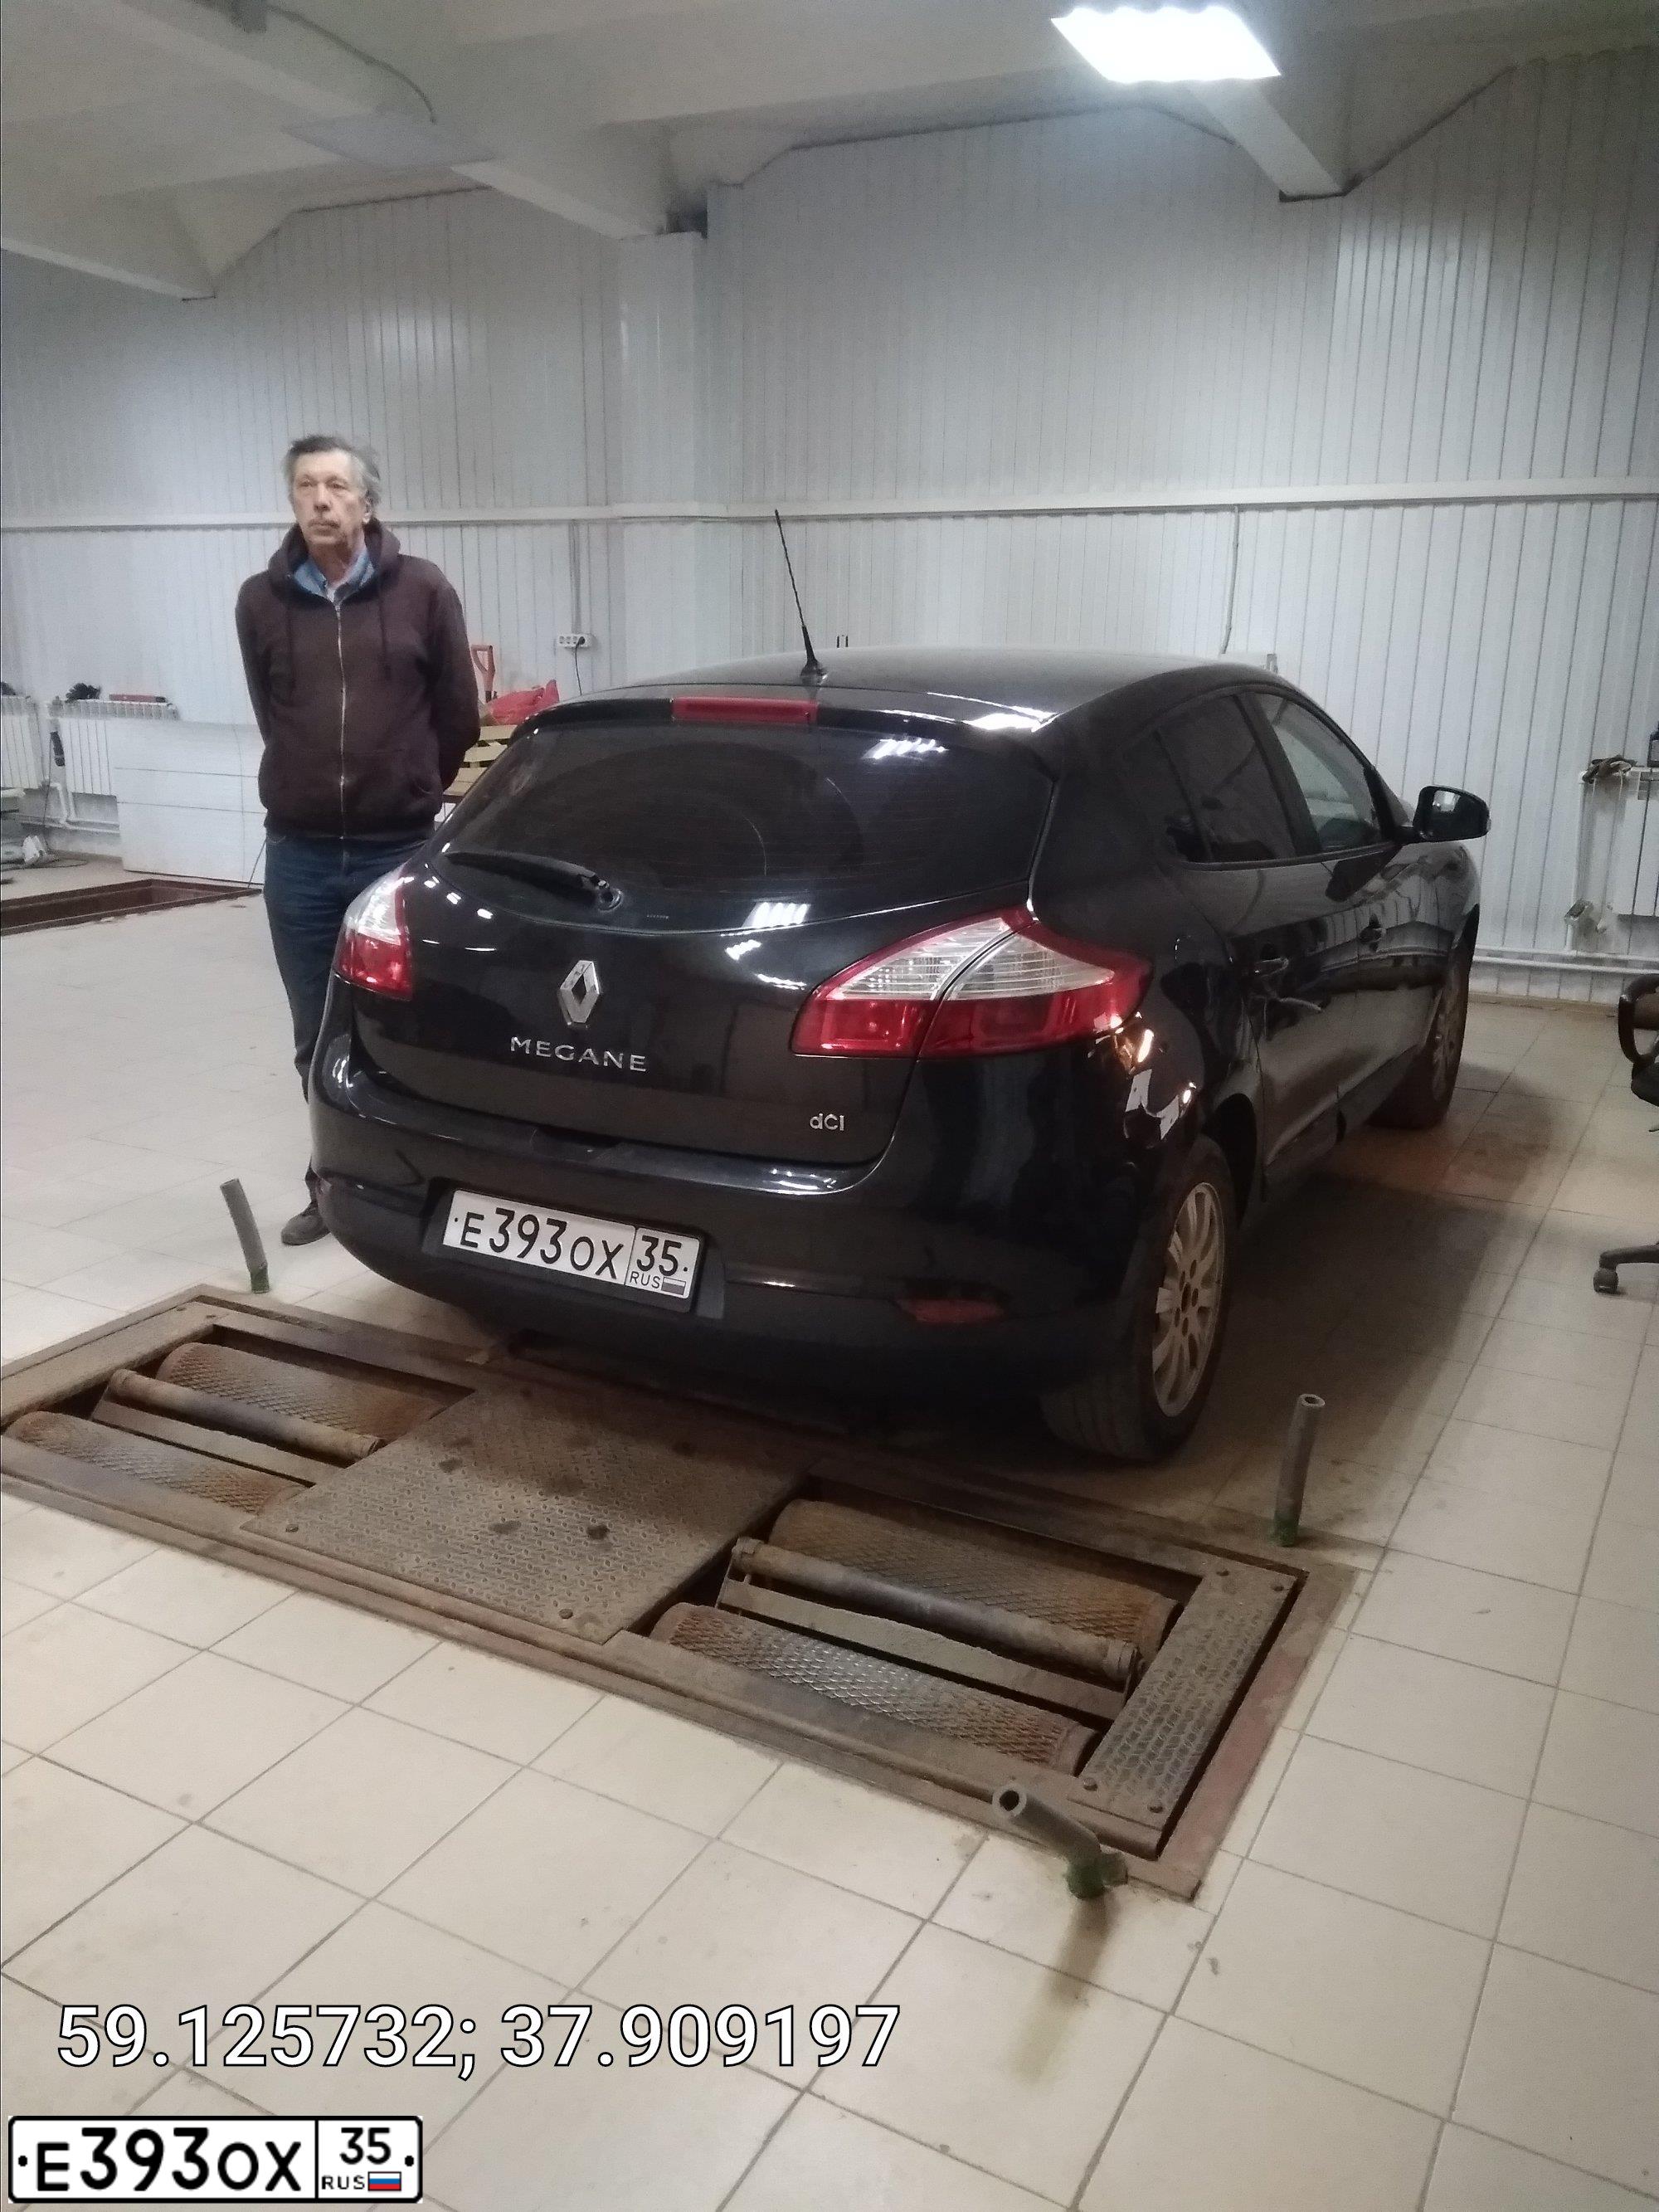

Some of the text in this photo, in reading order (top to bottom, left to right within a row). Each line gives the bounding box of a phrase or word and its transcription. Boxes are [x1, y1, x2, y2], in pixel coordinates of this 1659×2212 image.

[510, 1036, 646, 1072] MEGANE
[636, 1235, 682, 1277] 35
[630, 1270, 661, 1289] RUS
